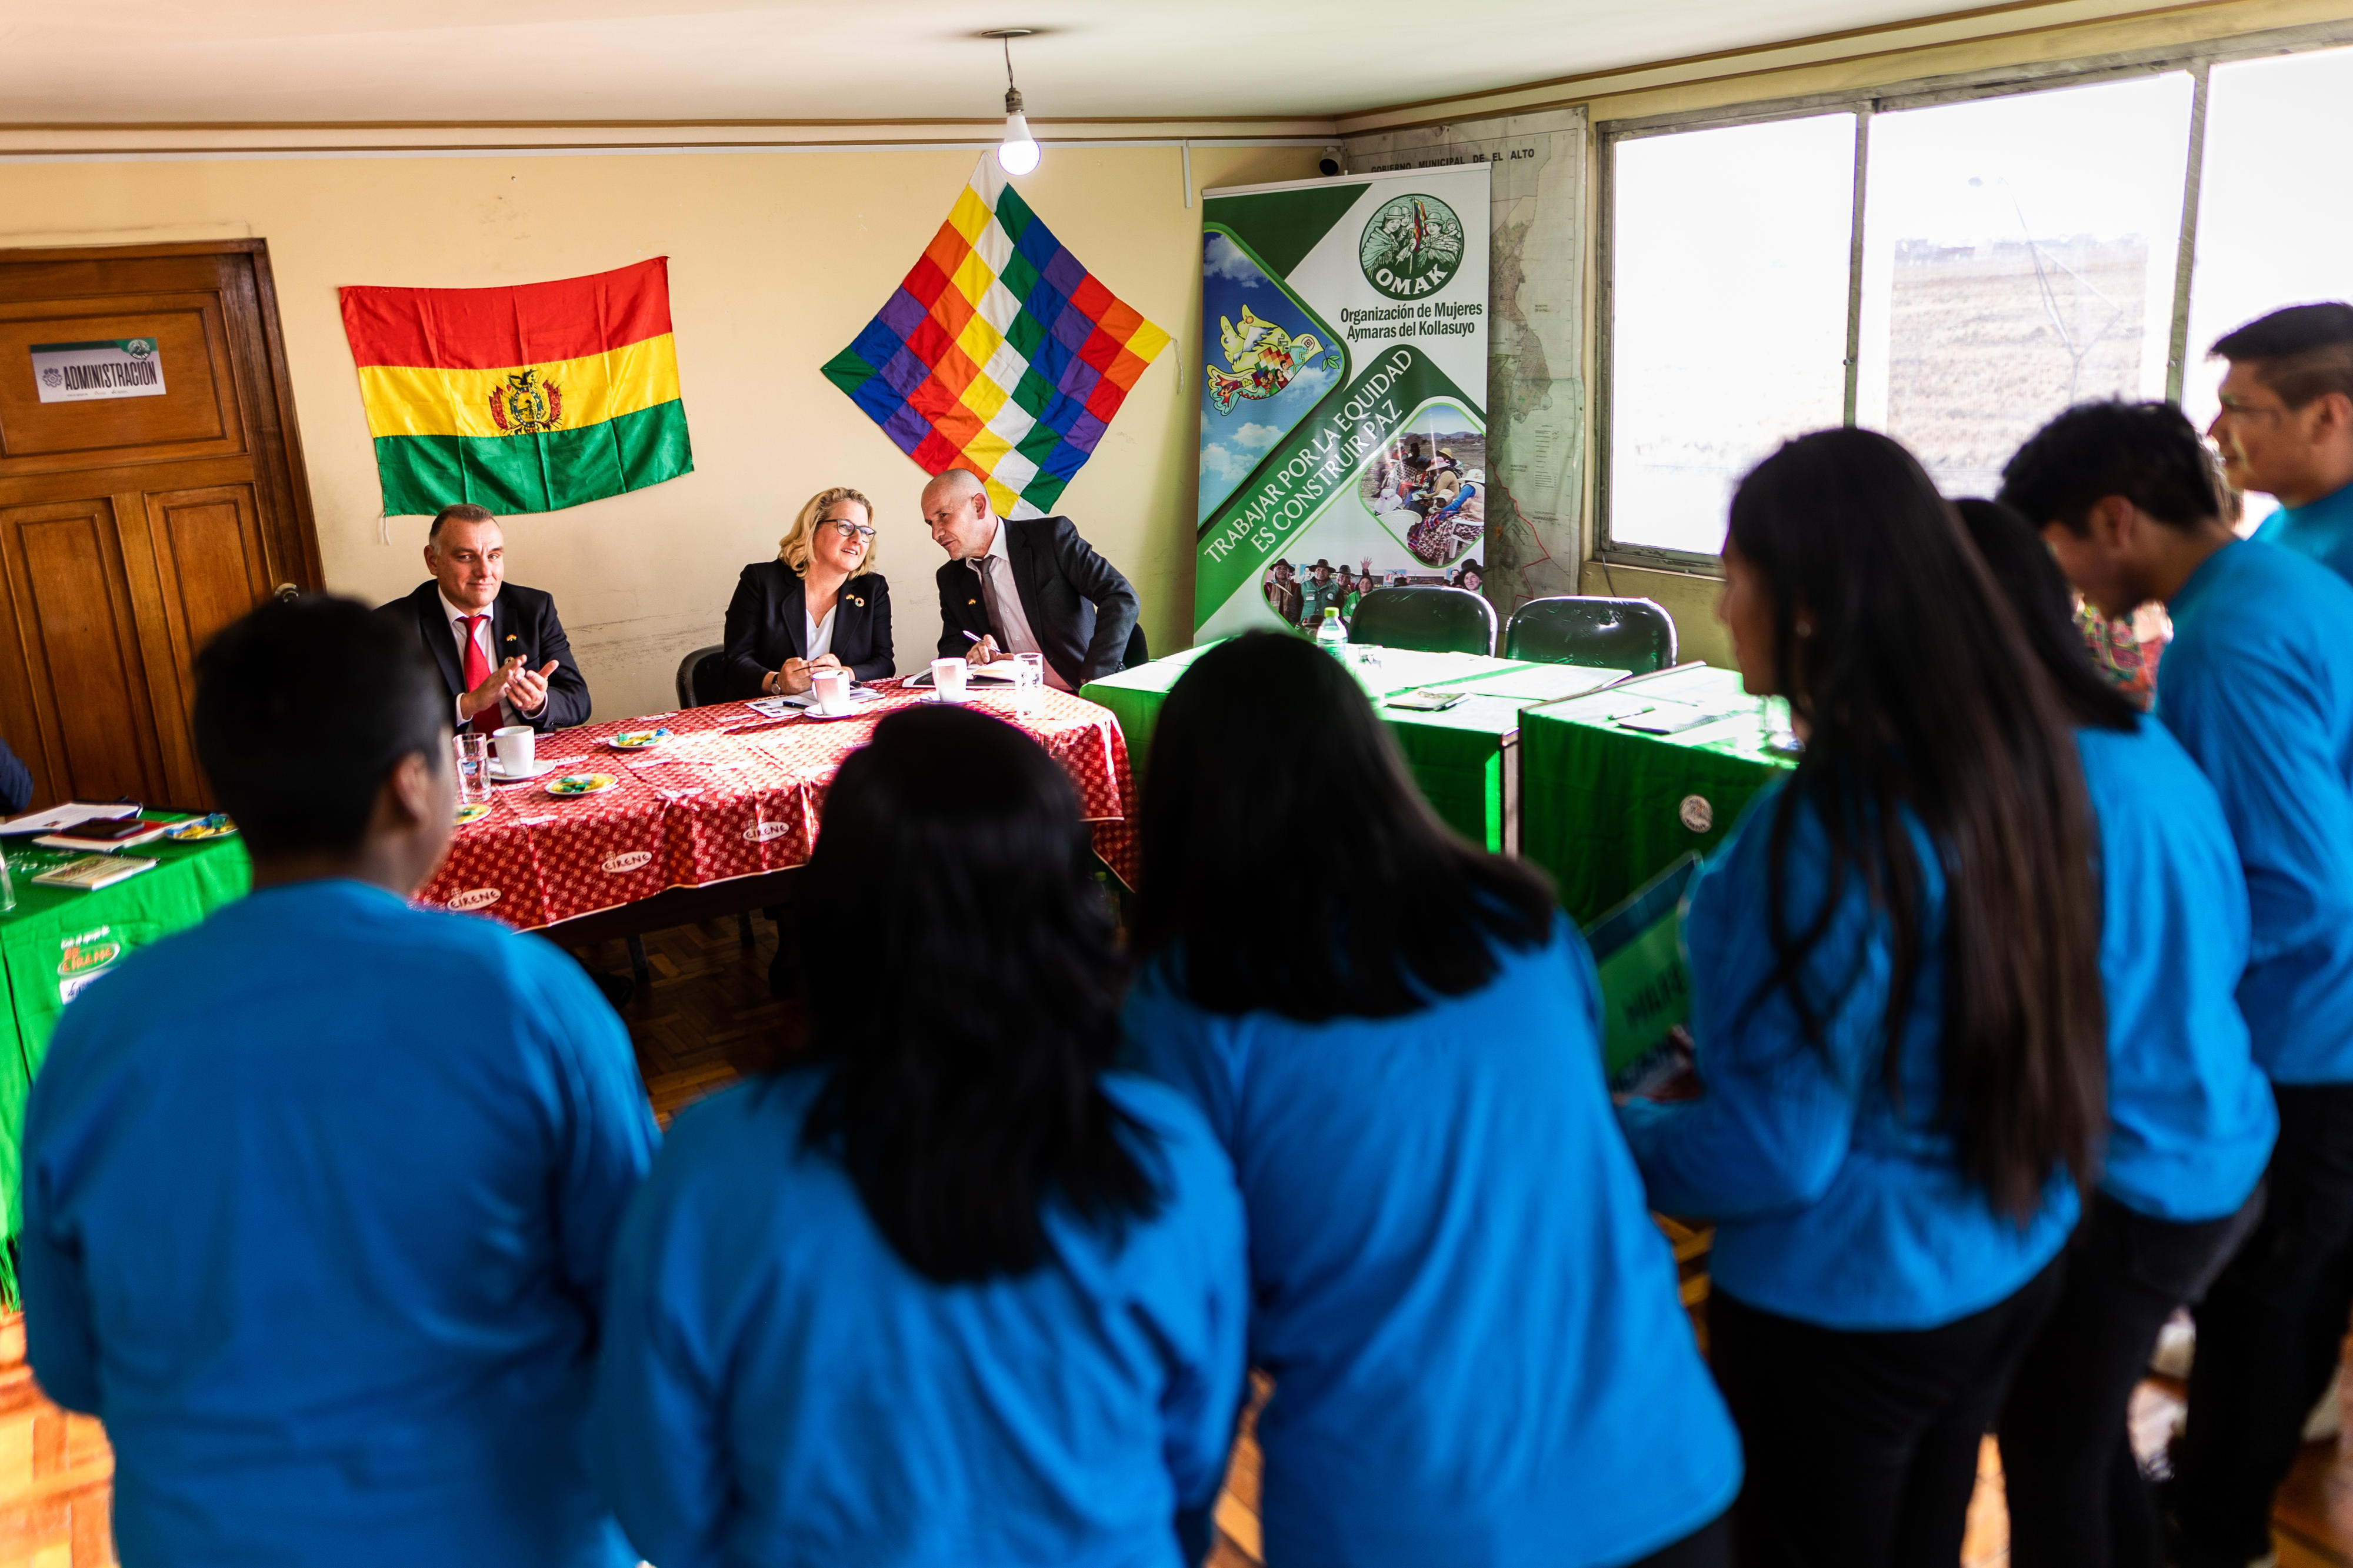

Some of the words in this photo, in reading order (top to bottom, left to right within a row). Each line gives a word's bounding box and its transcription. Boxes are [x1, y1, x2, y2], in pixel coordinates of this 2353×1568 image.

[1371, 162, 1411, 173] GOBIERNO
[1418, 156, 1465, 169] MUNICIPAL
[1473, 154, 1485, 164] DE
[1492, 152, 1503, 162] EL
[1511, 148, 1535, 160] ALTO
[1376, 263, 1448, 295] OMAK
[1341, 303, 1414, 325] Organización
[1417, 303, 1431, 318] de
[1435, 302, 1482, 320] Mujeres
[1347, 325, 1397, 342] Aymaras
[1399, 322, 1416, 337] del
[1419, 321, 1475, 337] Kollasuyo
[63, 359, 157, 391] ADMINISTRACIÓN
[1204, 483, 1285, 563] TRABAJAR
[1277, 448, 1321, 489] POR
[1311, 428, 1342, 453] LA
[1332, 350, 1412, 432] EQUIDAD
[1250, 526, 1276, 553] ES
[1272, 435, 1371, 531] CONSTRUIR
[1362, 399, 1403, 440] PAZ
[604, 853, 649, 870] EIRENE
[450, 890, 500, 909] EIRENE
